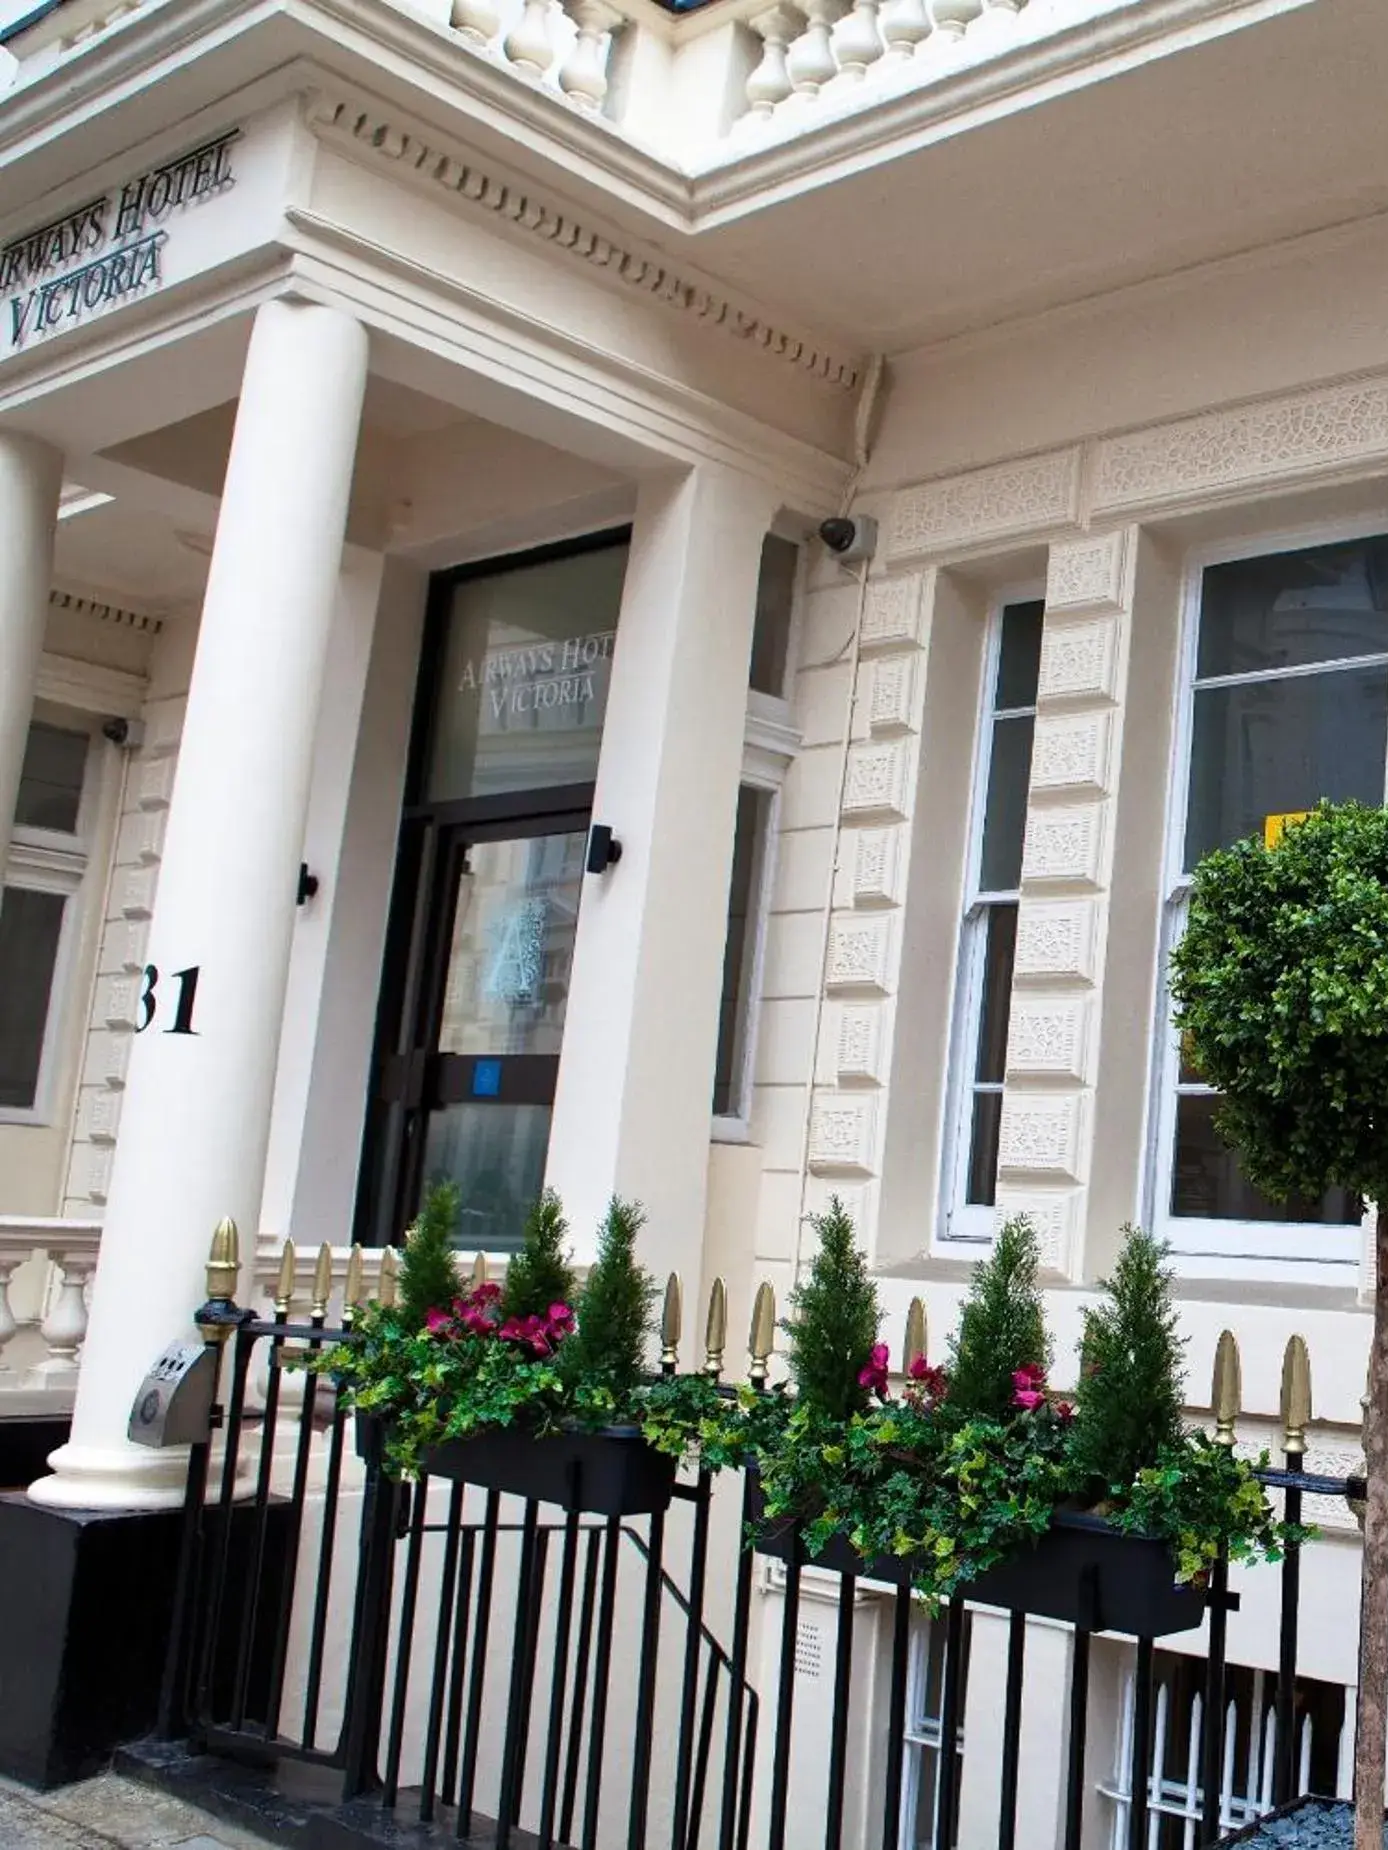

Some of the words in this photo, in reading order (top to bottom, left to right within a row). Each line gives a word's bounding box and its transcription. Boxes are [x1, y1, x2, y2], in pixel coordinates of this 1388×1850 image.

[0, 204, 106, 289] IRWAYS
[112, 144, 231, 241] HOTEL
[10, 240, 162, 345] VICTORIA
[458, 646, 554, 691] AIRWAYS
[561, 634, 614, 671] HOT
[489, 677, 595, 719] VICTORIA
[135, 964, 202, 1036] 31
